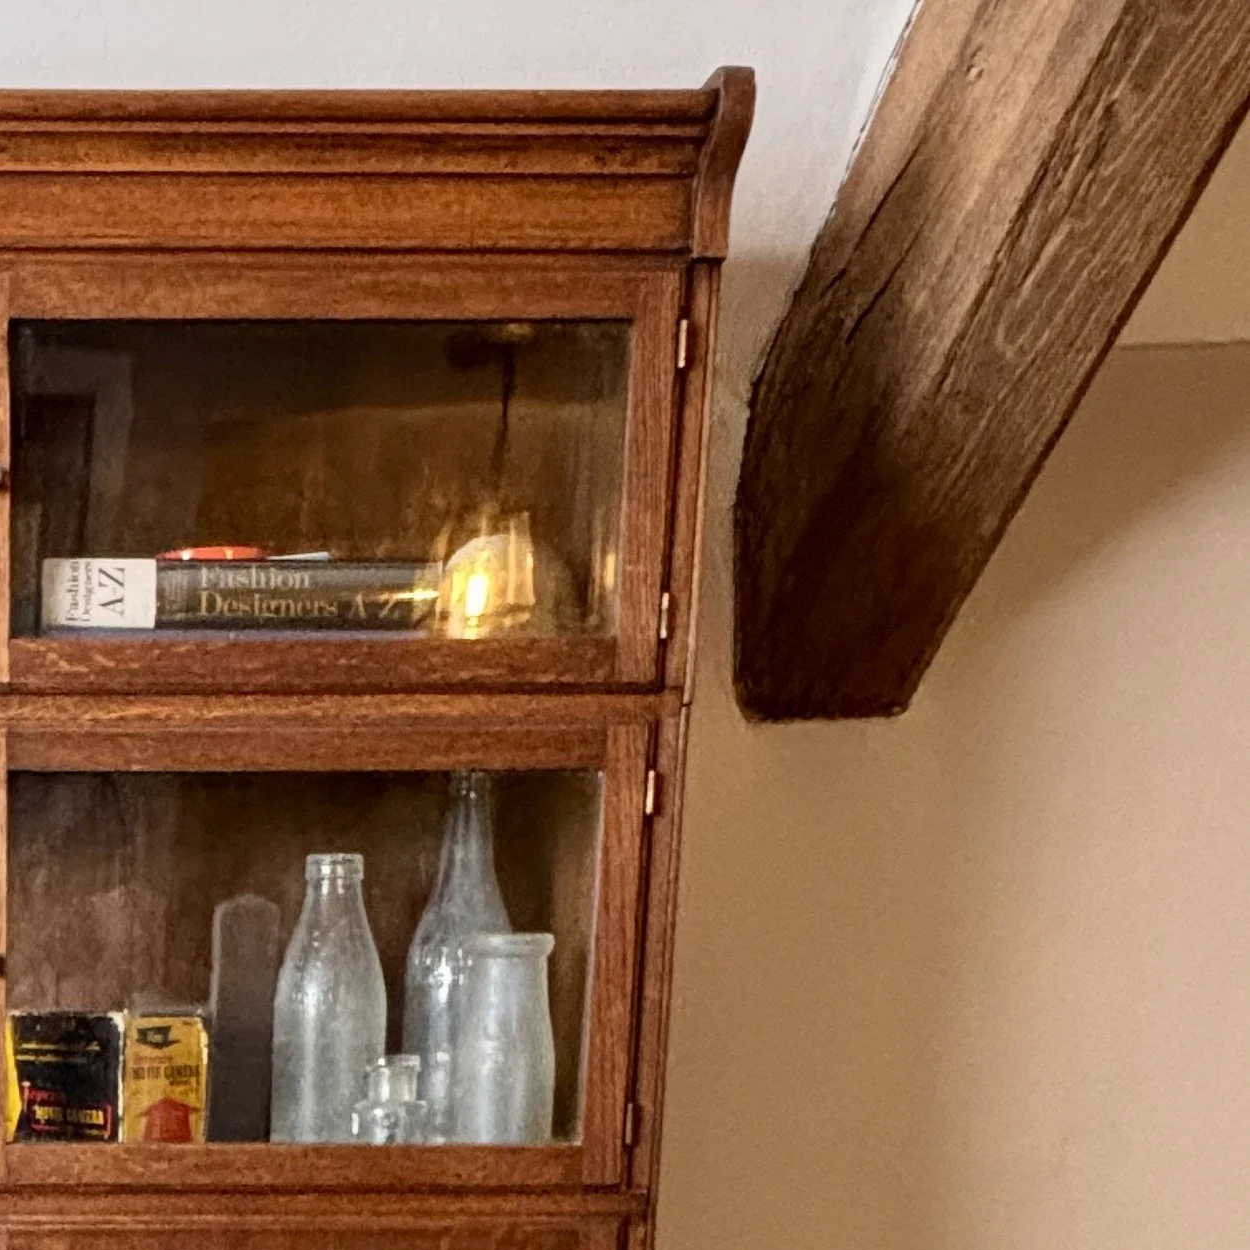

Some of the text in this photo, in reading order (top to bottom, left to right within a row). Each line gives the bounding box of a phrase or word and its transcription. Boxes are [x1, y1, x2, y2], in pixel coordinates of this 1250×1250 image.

[65, 561, 79, 621] Fashion
[200, 565, 310, 590] Fashion
[199, 590, 339, 620] Designers
